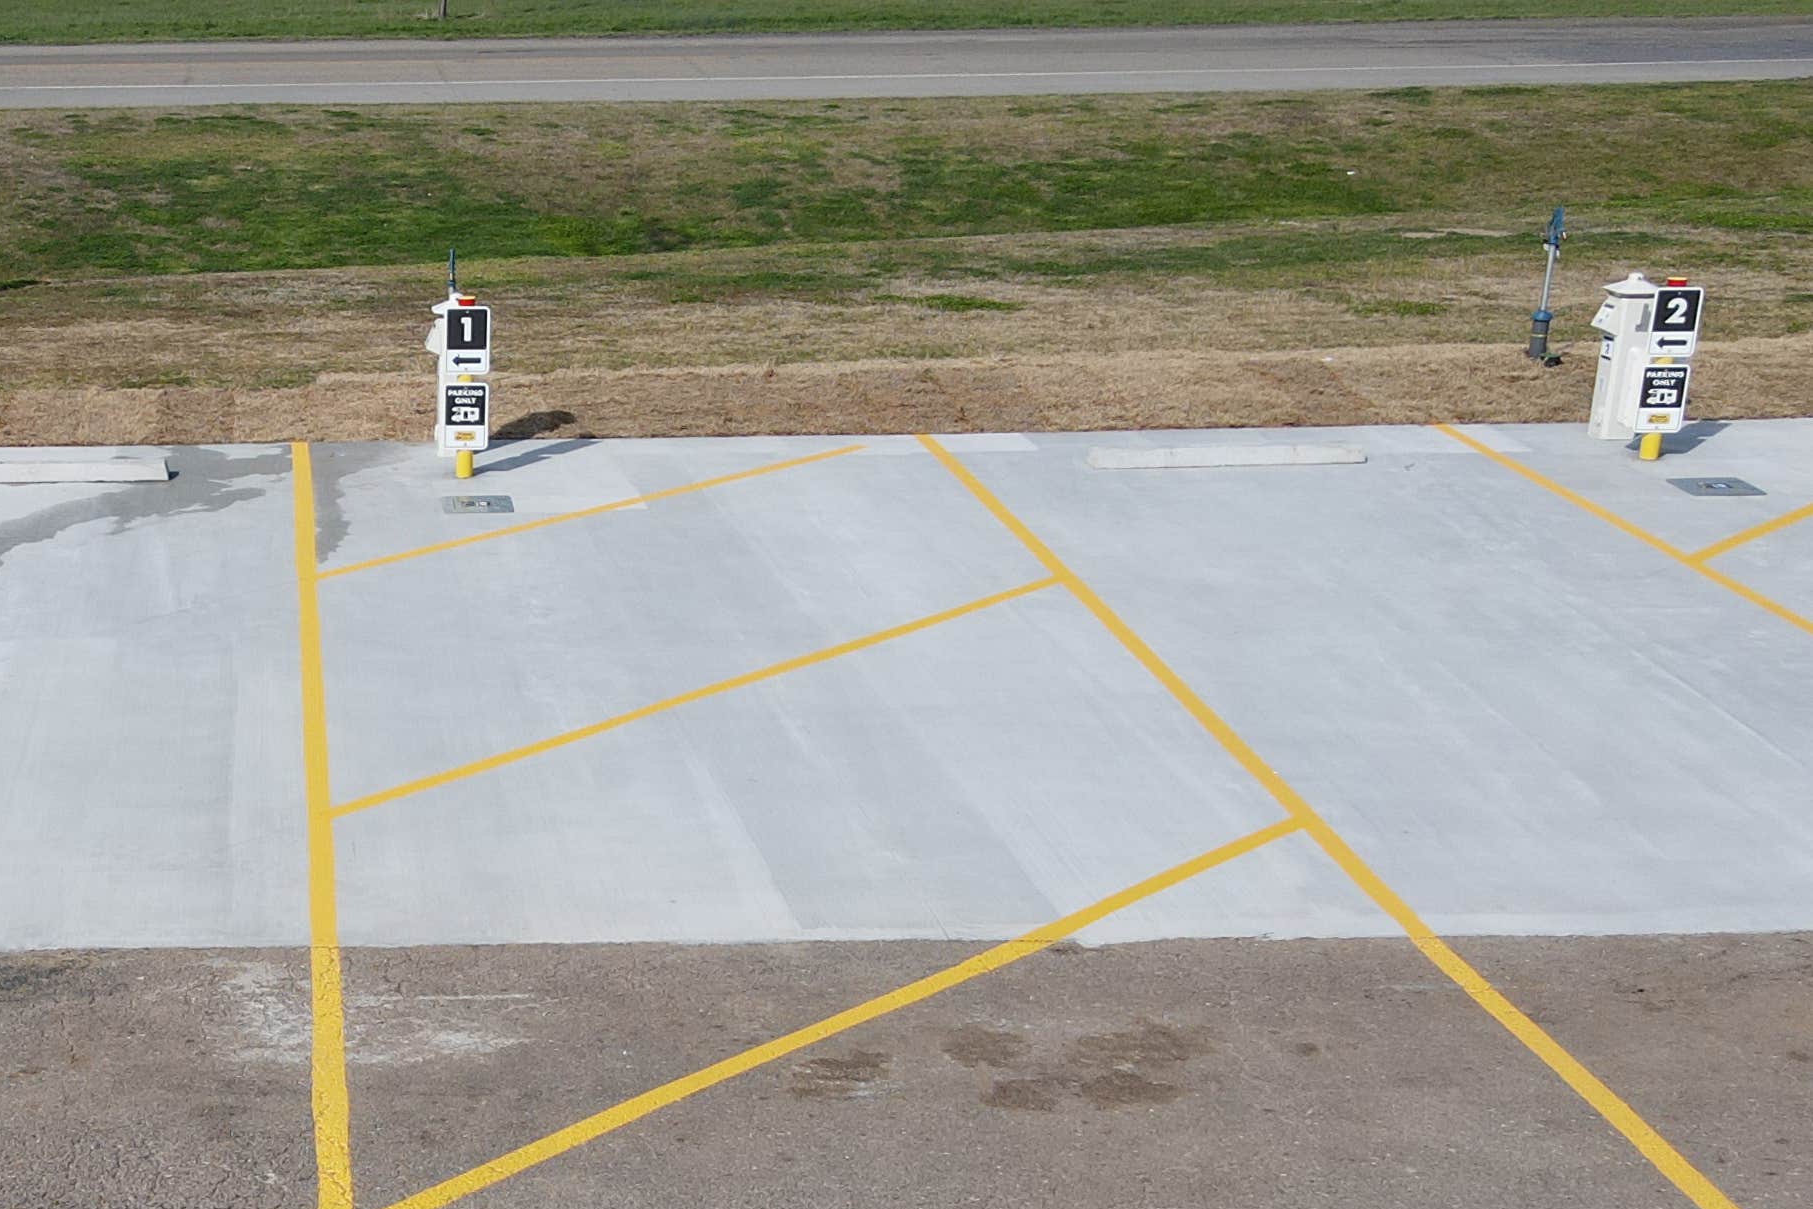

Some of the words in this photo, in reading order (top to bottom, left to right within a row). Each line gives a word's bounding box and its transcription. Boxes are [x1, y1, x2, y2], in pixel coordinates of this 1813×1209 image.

[1665, 298, 1688, 324] 2
[460, 317, 473, 342] 1
[1646, 370, 1685, 379] PARKING
[447, 389, 484, 397] PARKING
